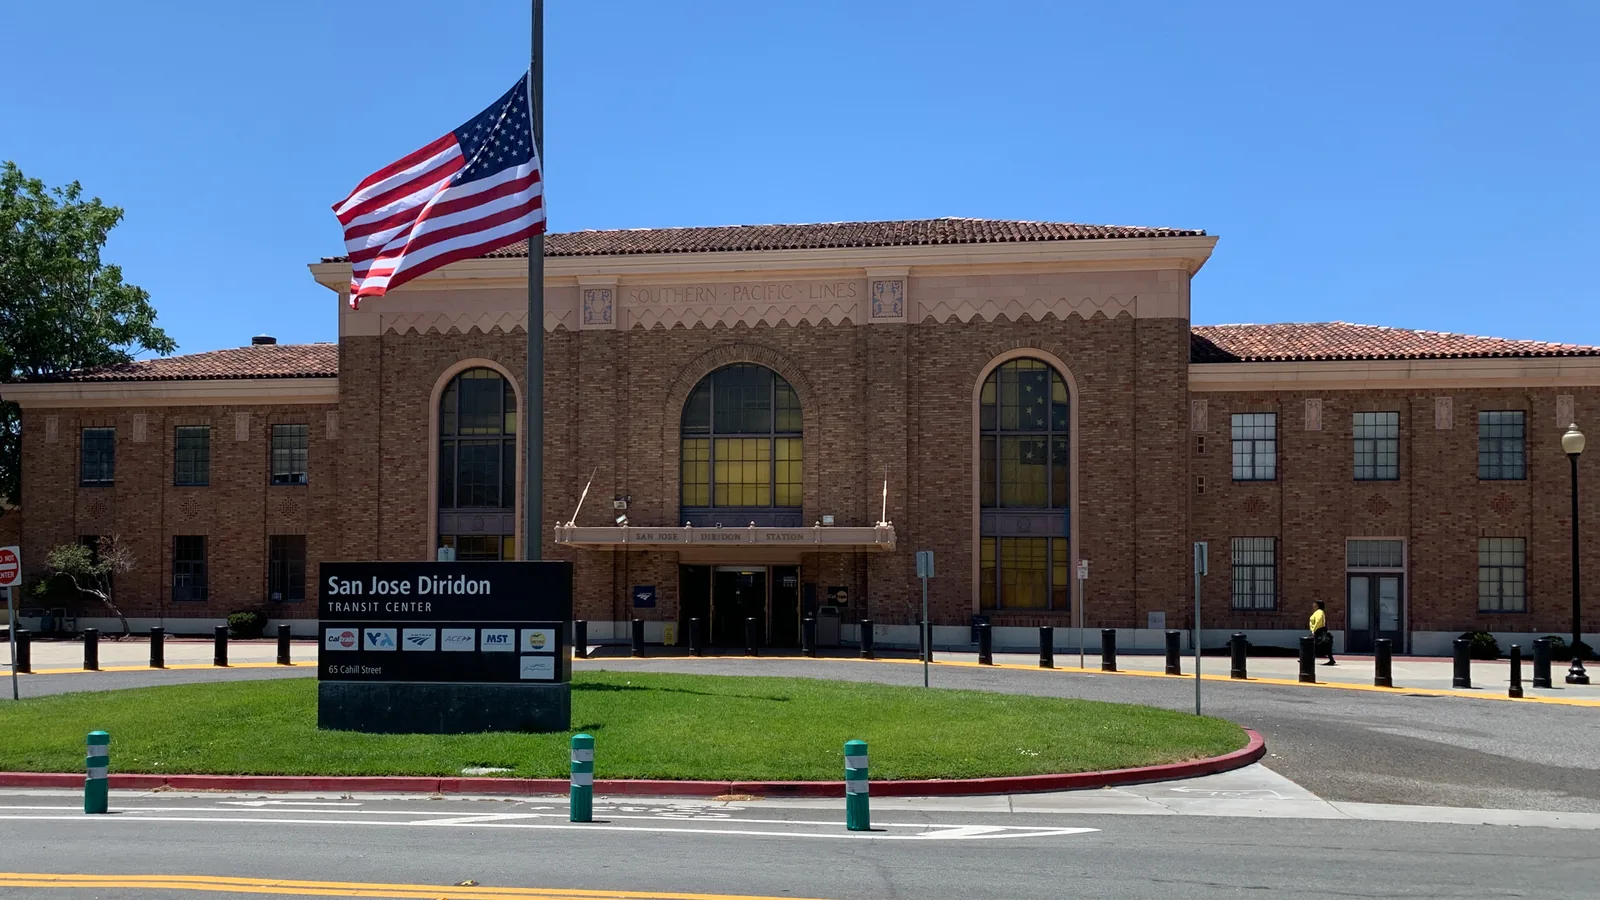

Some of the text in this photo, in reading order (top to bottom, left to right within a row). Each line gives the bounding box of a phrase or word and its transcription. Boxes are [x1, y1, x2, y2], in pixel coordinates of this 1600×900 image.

[629, 281, 857, 304] SOUTHERN PACIFIC LINES
[636, 533, 804, 541] SAN JOSE DIRIDON STATION
[328, 574, 491, 595] San Jose Diridon
[328, 602, 432, 612] TRANSIT CENTER
[486, 634, 509, 643] MST
[328, 664, 382, 674] 65 Cahill Street
